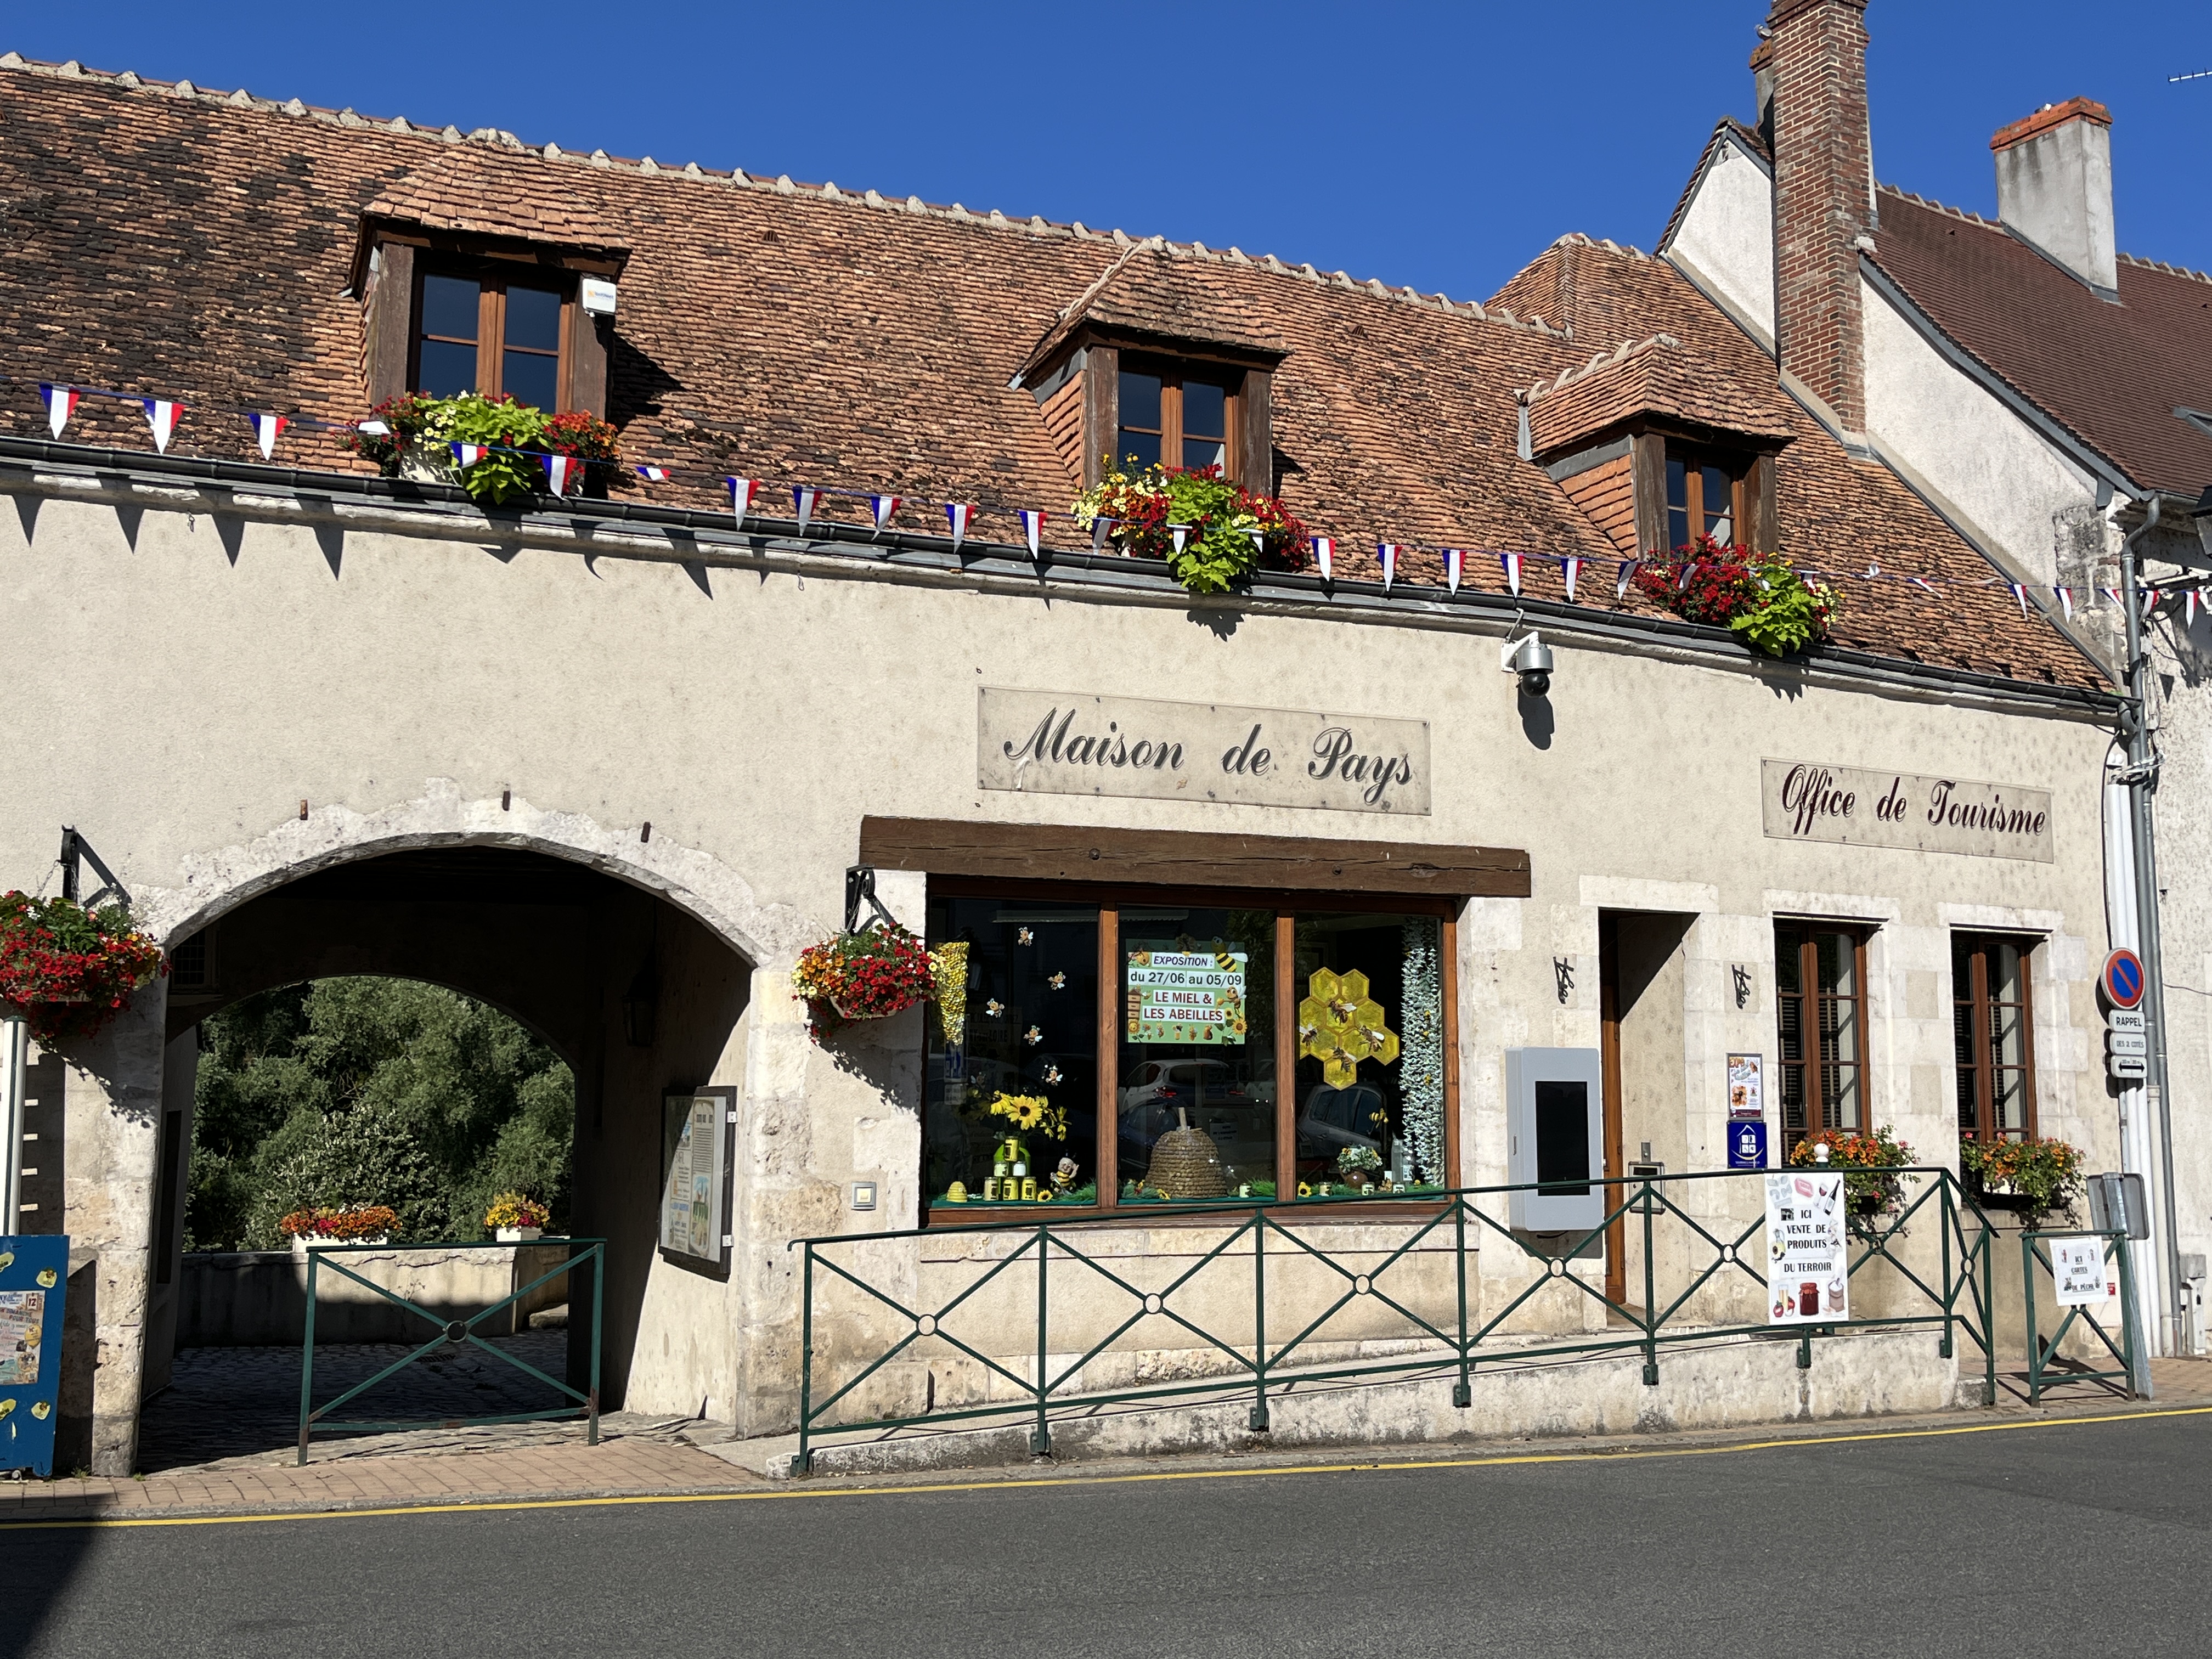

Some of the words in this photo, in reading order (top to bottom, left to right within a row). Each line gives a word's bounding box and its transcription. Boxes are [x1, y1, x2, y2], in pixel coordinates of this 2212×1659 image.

[1003, 707, 1184, 770] Maison
[1222, 724, 1272, 776] de
[1308, 727, 1413, 804] Pays
[1782, 764, 1855, 834] Office
[1876, 777, 1907, 822] de
[1928, 780, 2046, 836] Tourisme
[1154, 956, 1208, 967] EXPOSITION
[1130, 972, 1144, 981] du
[1148, 972, 1185, 985] 27/06
[1188, 976, 1203, 984] au
[1206, 975, 1242, 988] 05/09
[1155, 991, 1169, 1003] LE
[1172, 992, 1200, 1004] MIEL
[1203, 994, 1212, 1004] &
[1144, 1008, 1165, 1019] LES
[1169, 1009, 1223, 1021] ABEILLES
[2116, 1017, 2142, 1027] RAPPEL
[1801, 1209, 1812, 1219] ICI
[1787, 1224, 1811, 1234] VENTE
[1815, 1224, 1827, 1234] DE
[1787, 1239, 1827, 1249] PRODUITS
[1784, 1263, 1796, 1273] DU
[1797, 1262, 1832, 1272] TERROIR
